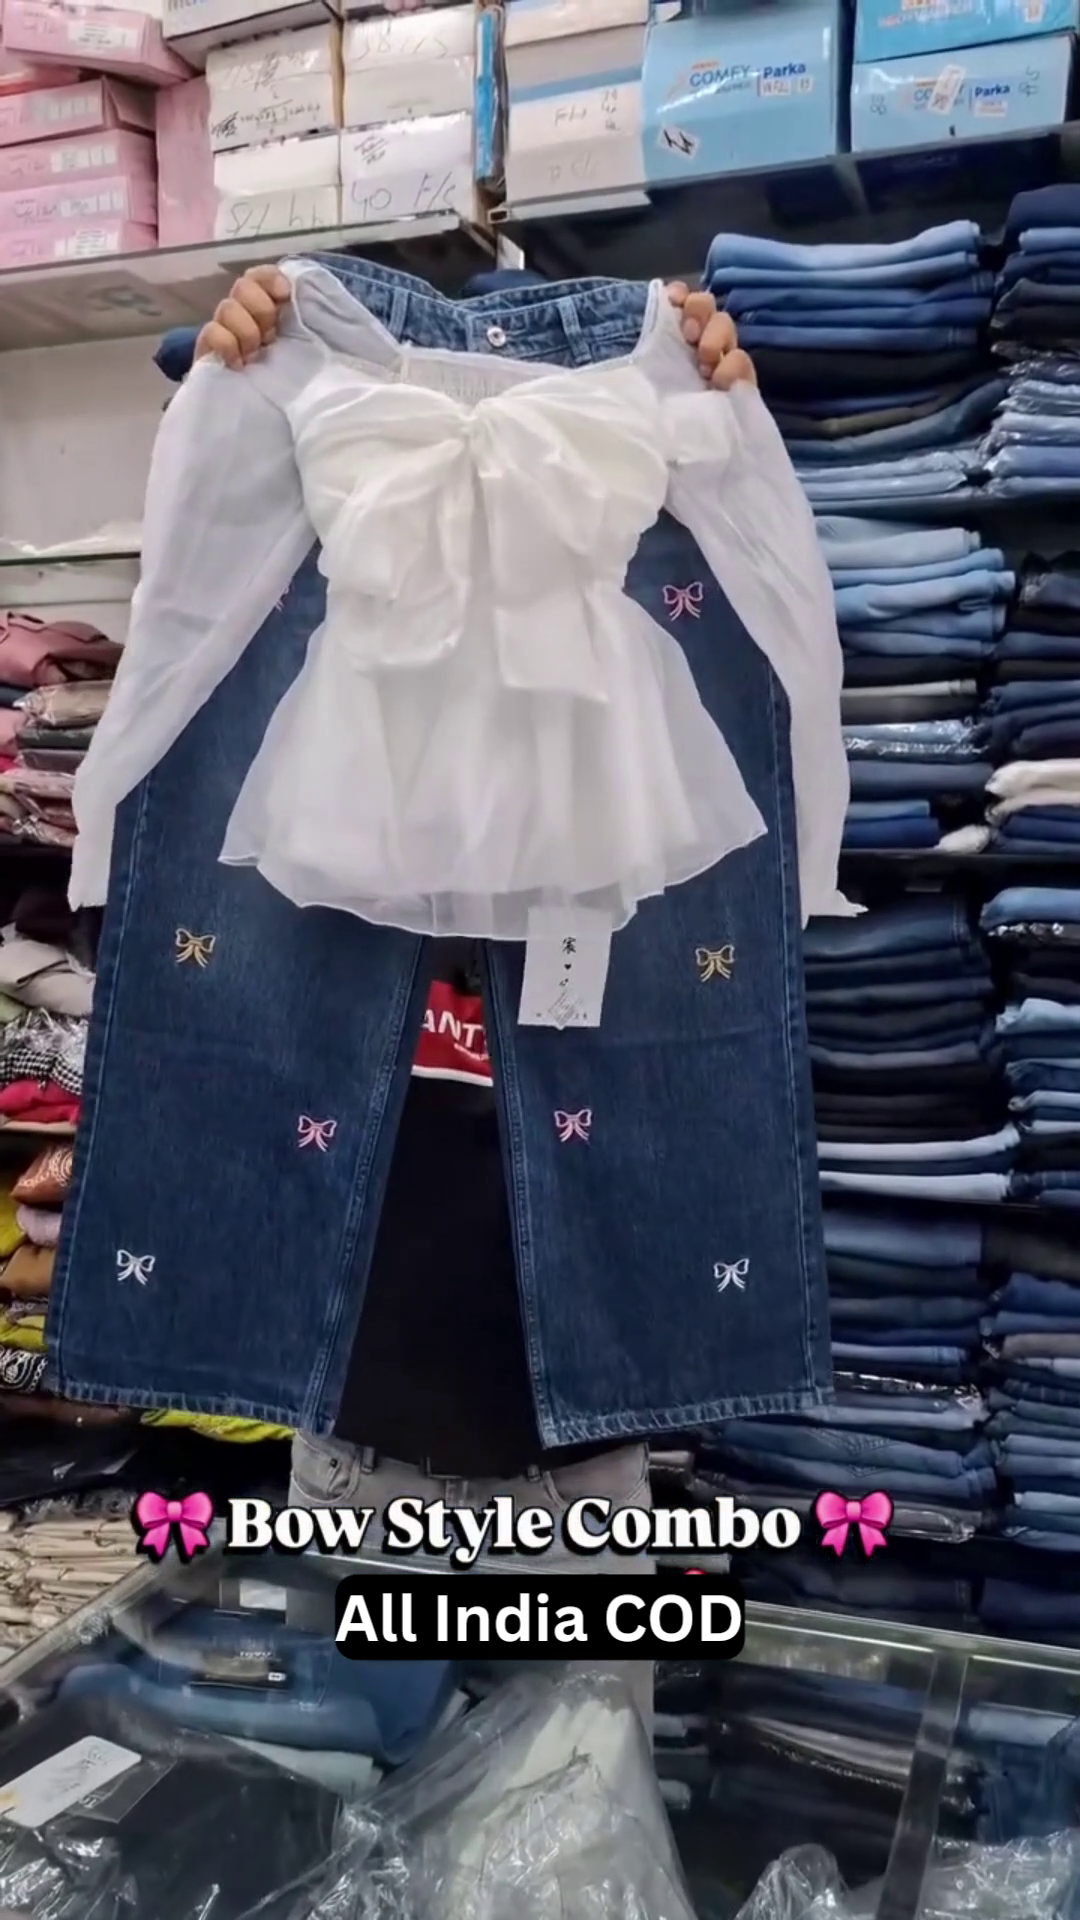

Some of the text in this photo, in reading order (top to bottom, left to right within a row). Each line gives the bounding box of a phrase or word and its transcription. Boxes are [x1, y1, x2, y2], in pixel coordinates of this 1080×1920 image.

[690, 65, 752, 87] COMFY
[763, 63, 806, 79] Parka
[974, 83, 1011, 97] Parka
[421, 1009, 486, 1049] ANT
